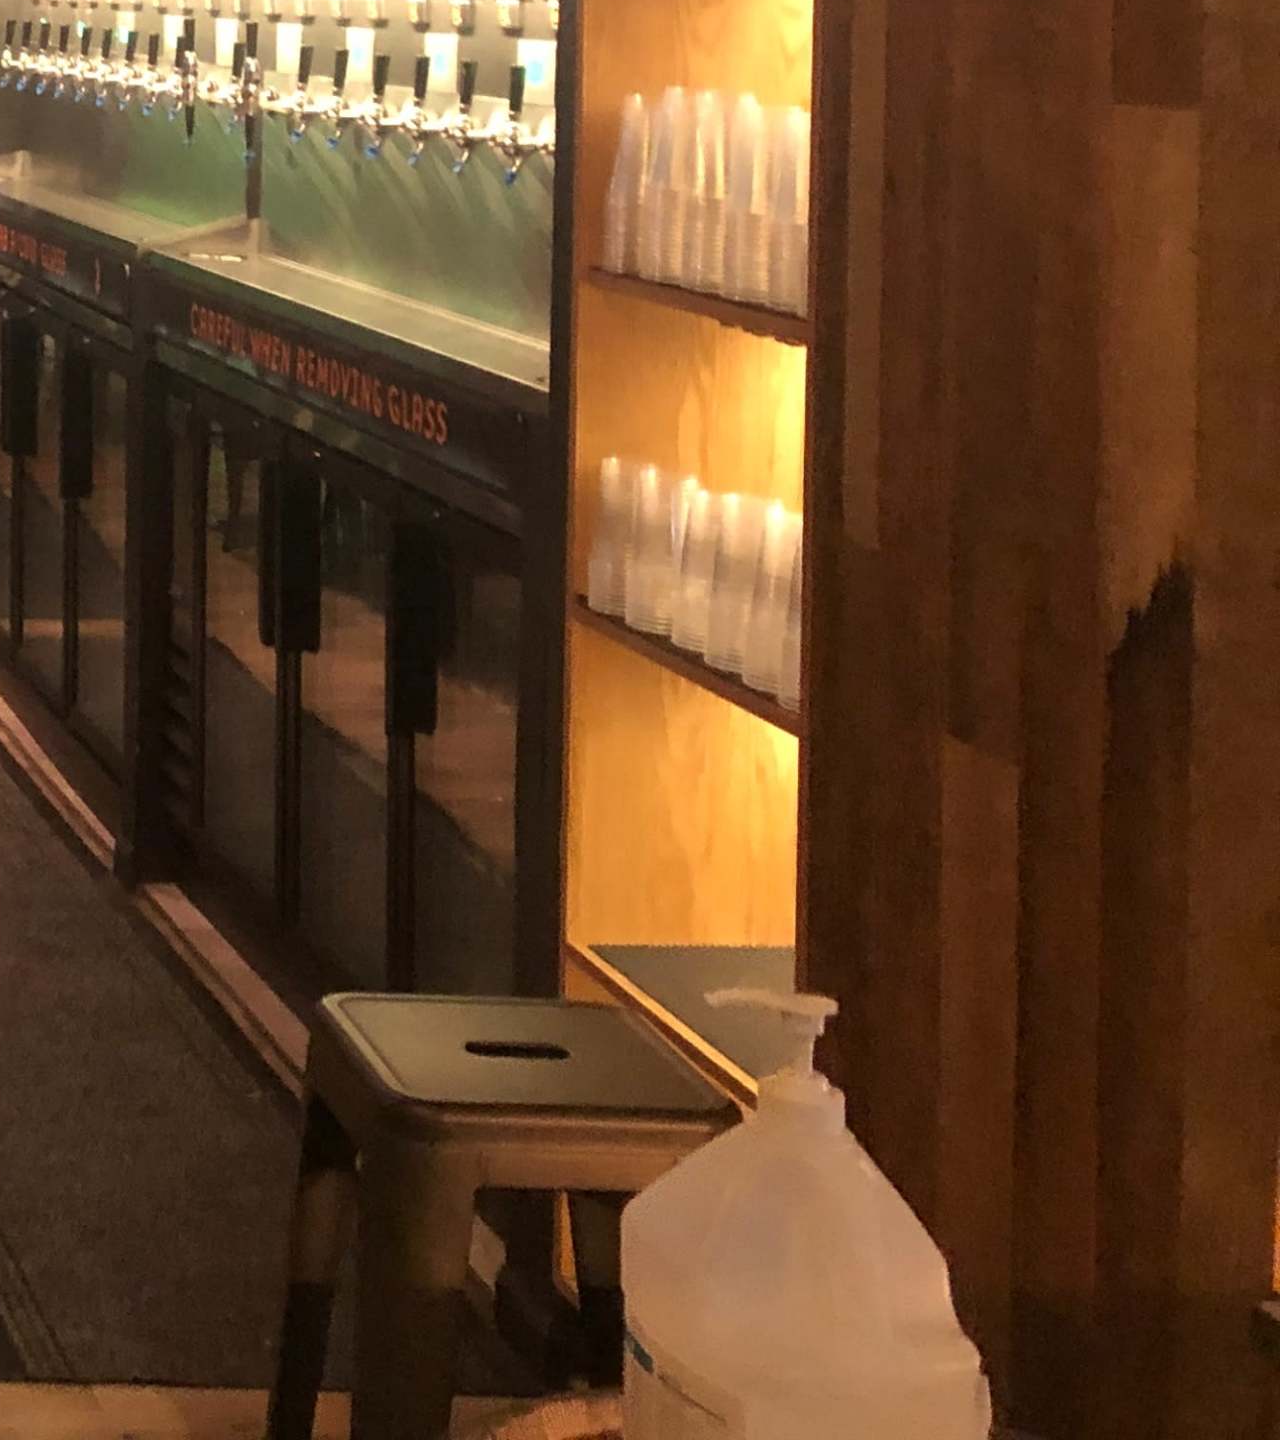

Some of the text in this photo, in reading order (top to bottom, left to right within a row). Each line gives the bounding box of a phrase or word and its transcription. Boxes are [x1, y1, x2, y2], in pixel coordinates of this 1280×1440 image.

[190, 302, 449, 445] CAREFUL WHEN REMOVING GLASS
